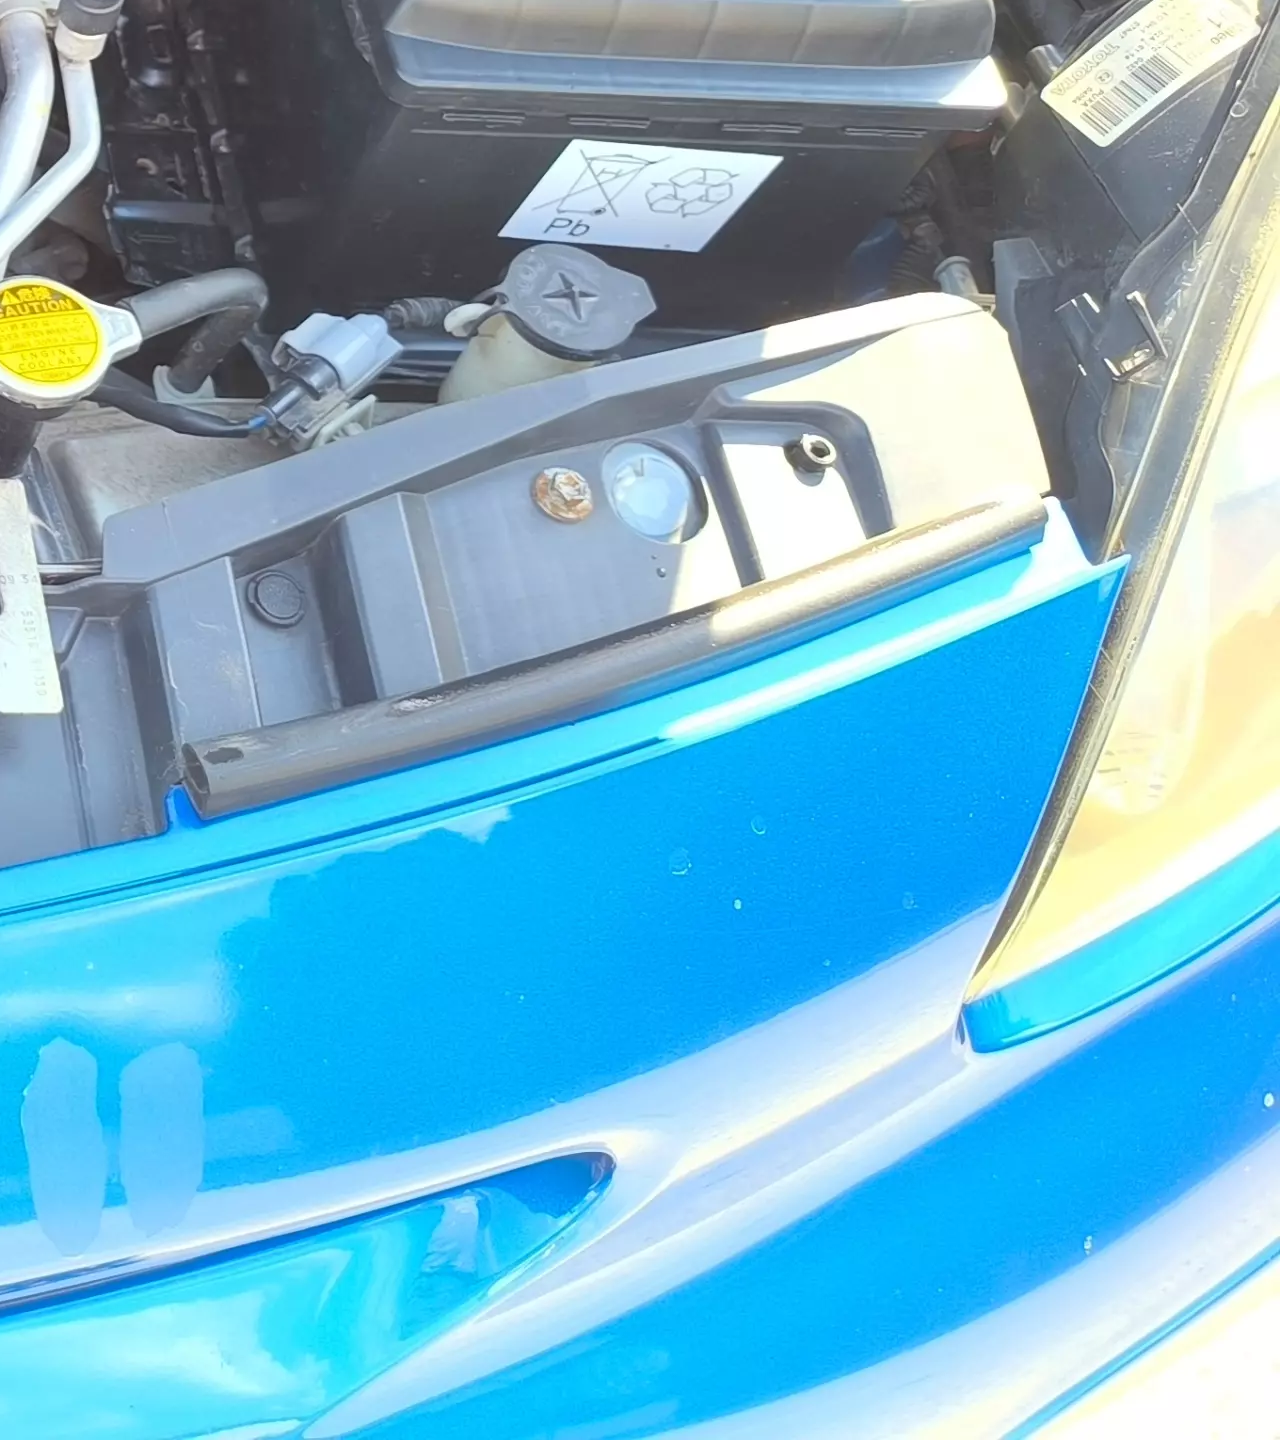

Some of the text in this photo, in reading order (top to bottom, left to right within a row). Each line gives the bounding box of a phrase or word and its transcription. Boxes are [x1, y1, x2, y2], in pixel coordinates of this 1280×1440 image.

[1049, 40, 1119, 97] TOYOTA
[542, 216, 590, 237] Pb
[21, 347, 77, 361] ENGINE
[18, 356, 82, 371] COOLANT
